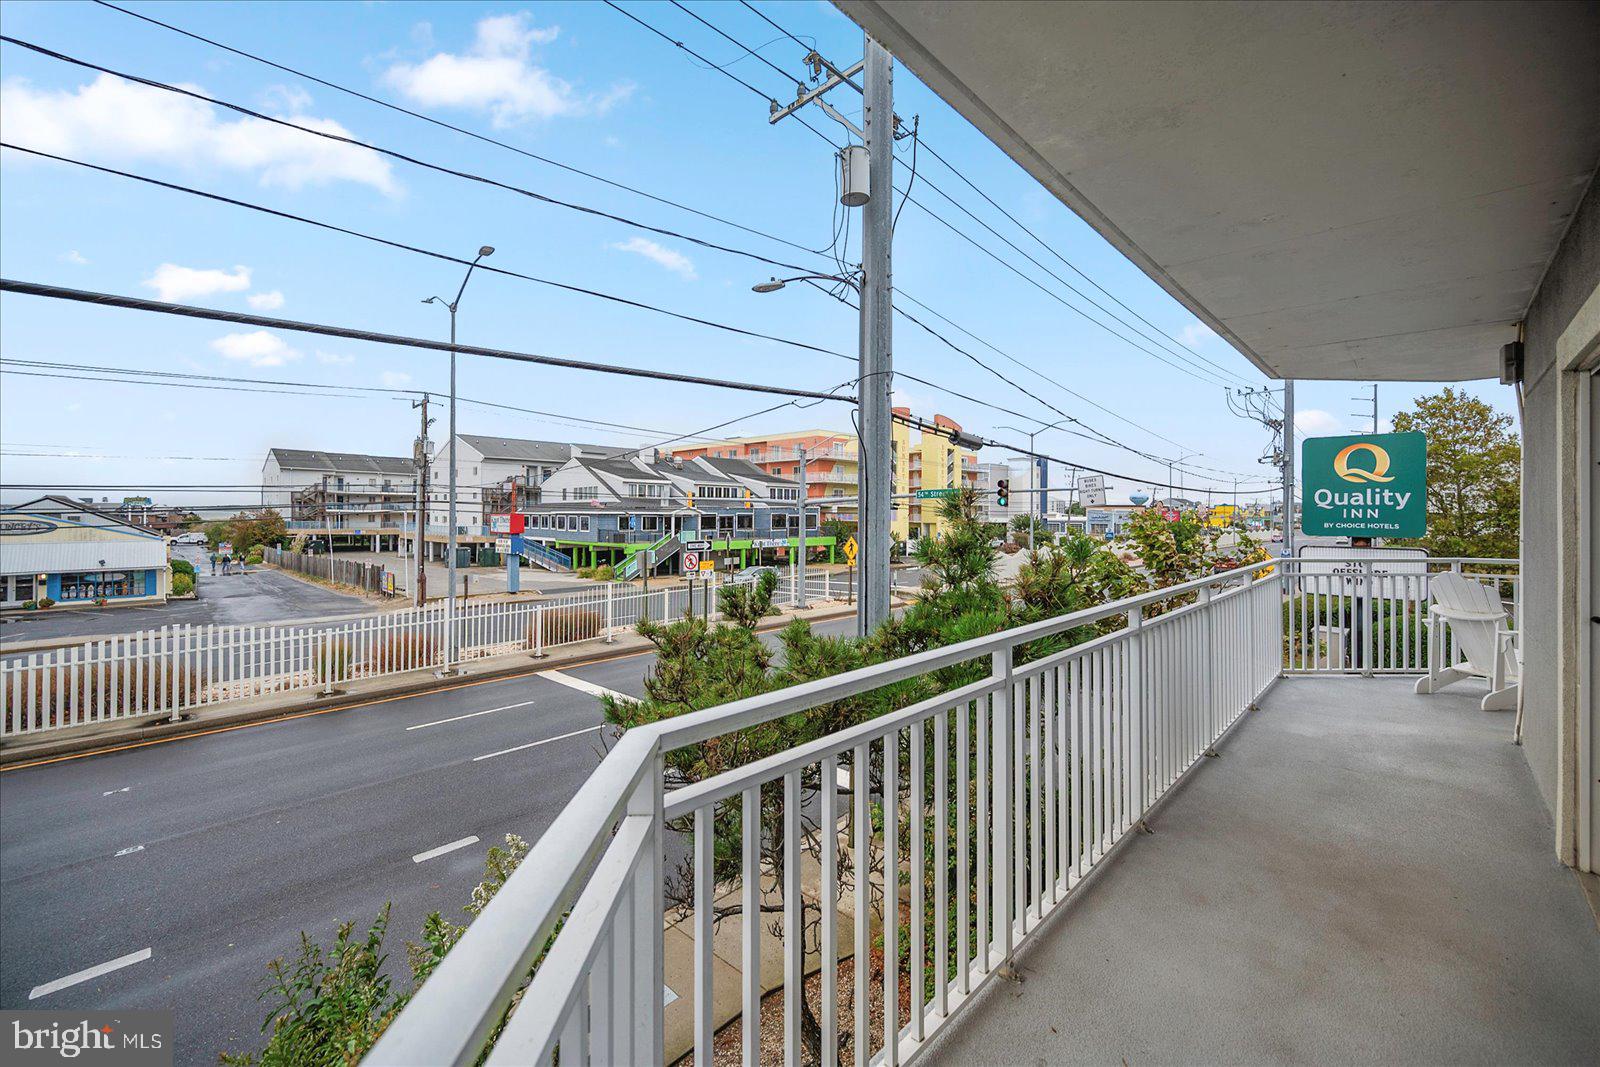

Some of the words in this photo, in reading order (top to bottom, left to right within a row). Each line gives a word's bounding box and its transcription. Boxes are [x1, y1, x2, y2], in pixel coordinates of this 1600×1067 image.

[1334, 443, 1395, 483] Q
[1314, 488, 1411, 510] Quality
[1343, 508, 1379, 519] INN
